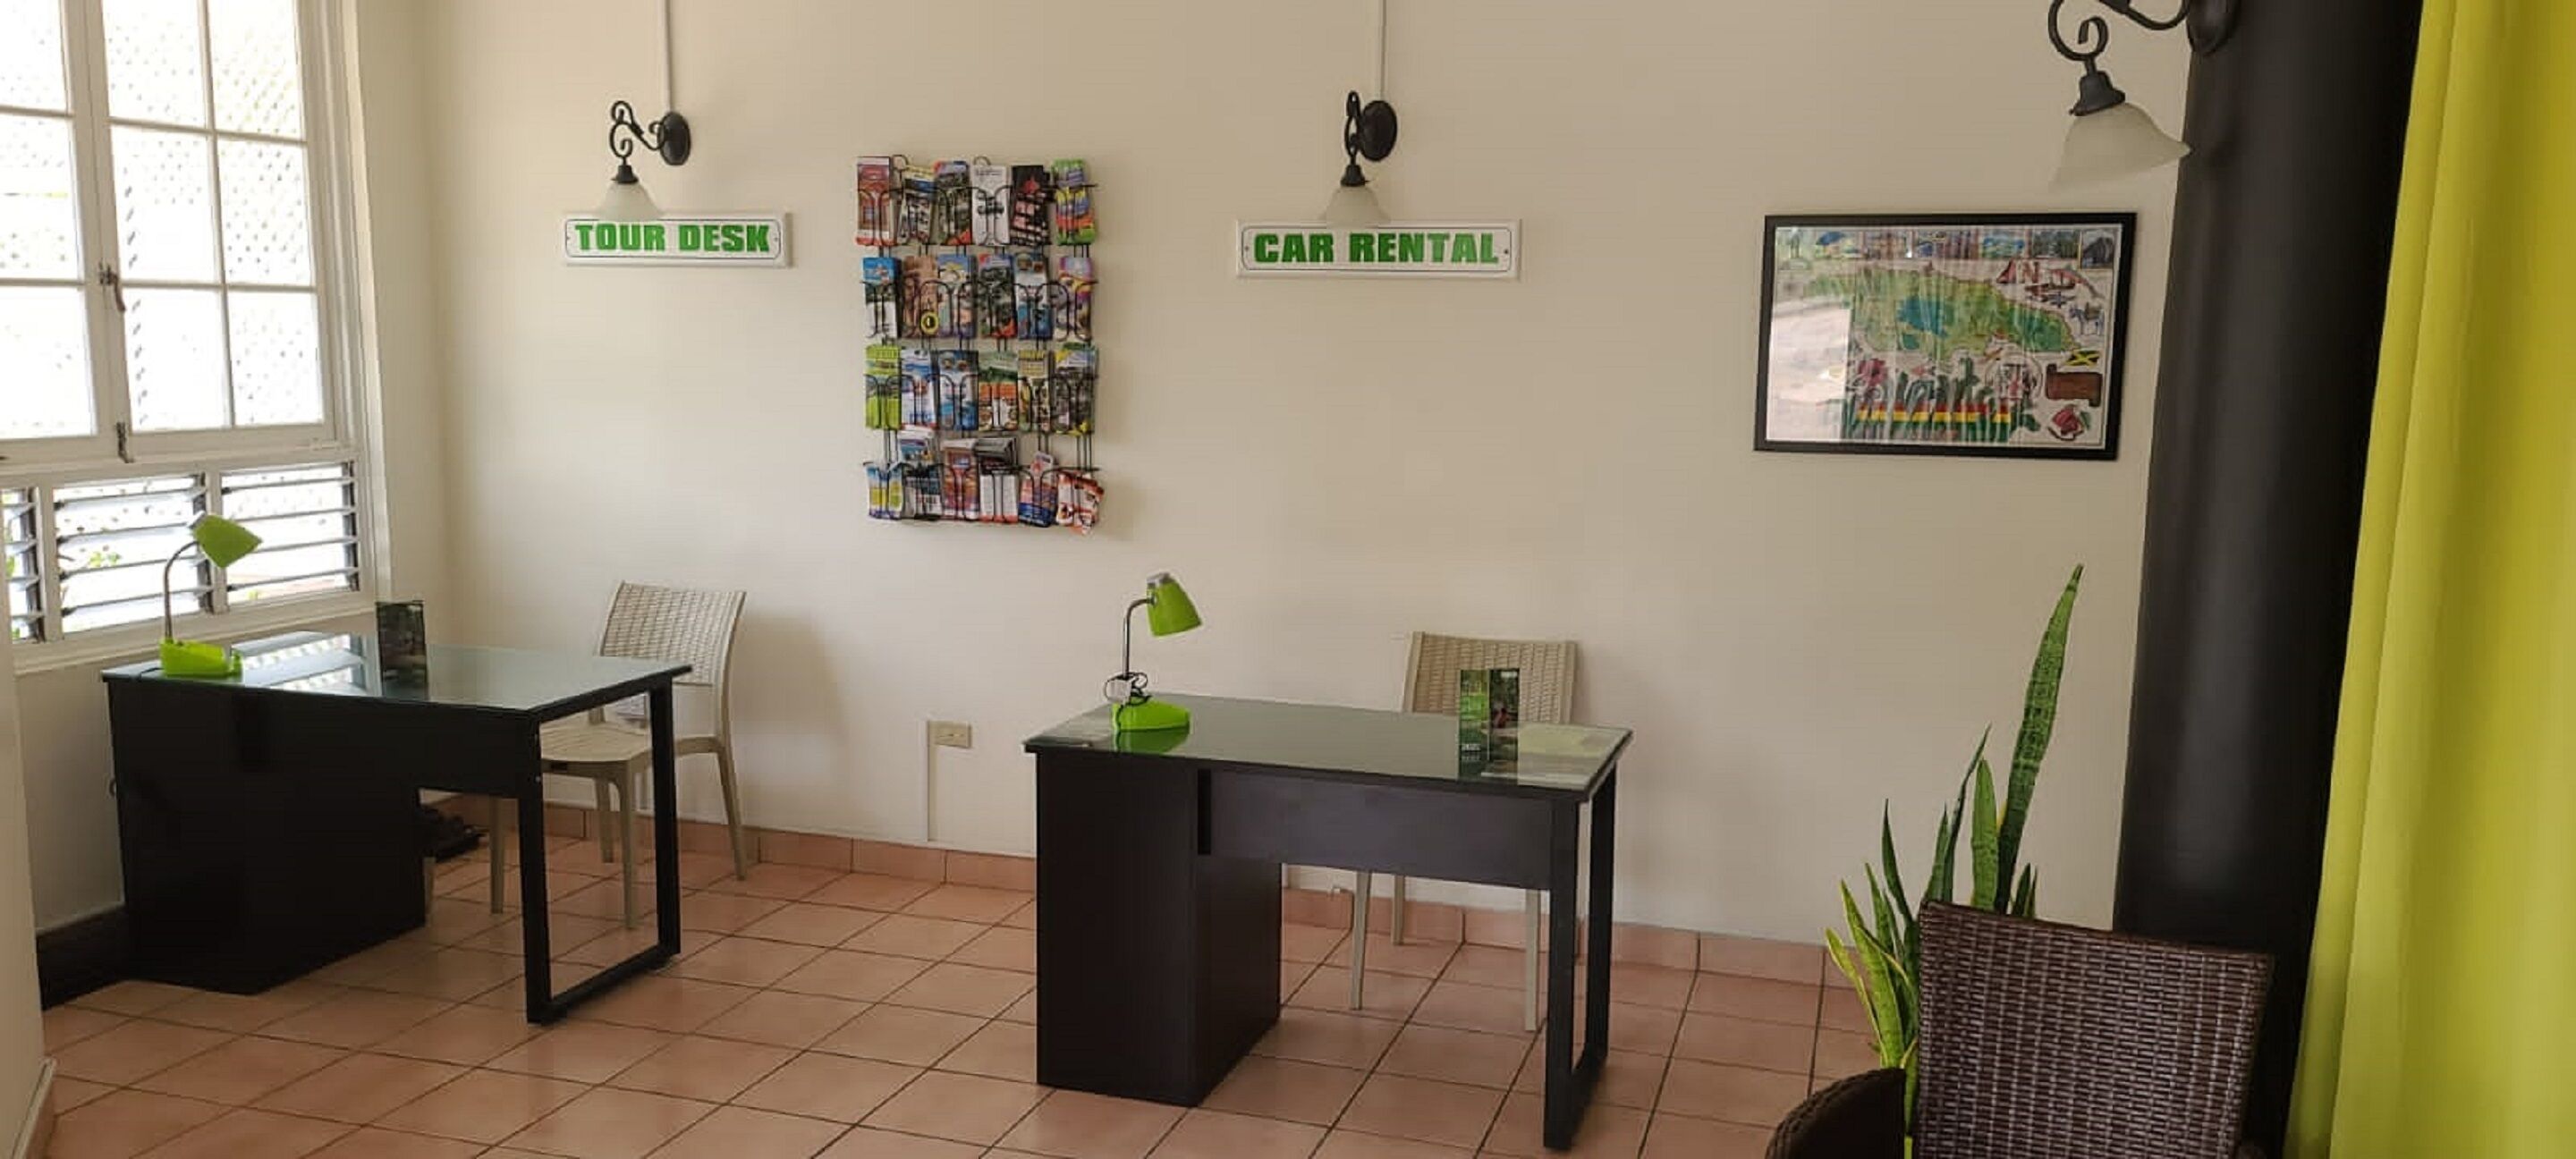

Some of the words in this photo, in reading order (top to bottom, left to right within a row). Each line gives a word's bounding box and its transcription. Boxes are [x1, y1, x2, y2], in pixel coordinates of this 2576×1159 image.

[575, 223, 665, 252] TOUR
[677, 224, 770, 253] DESK
[1253, 233, 1335, 263] CAR
[1349, 232, 1499, 264] RENTAL
